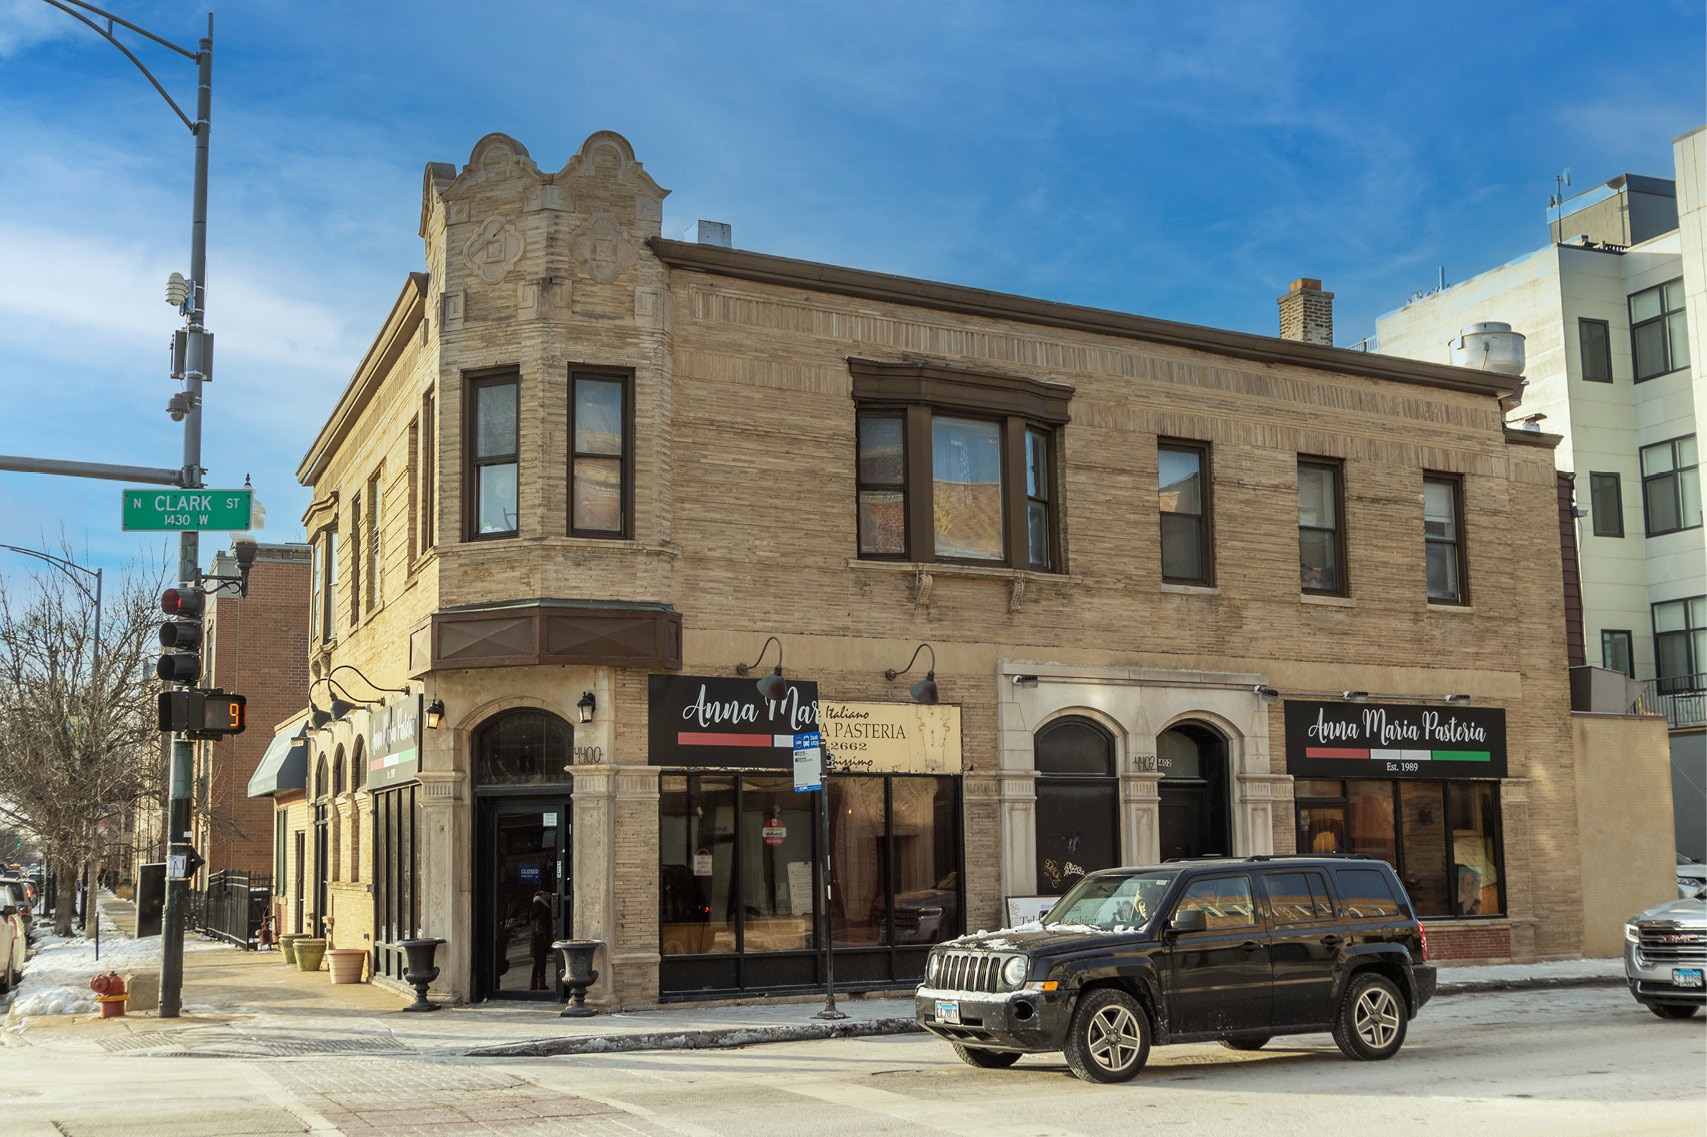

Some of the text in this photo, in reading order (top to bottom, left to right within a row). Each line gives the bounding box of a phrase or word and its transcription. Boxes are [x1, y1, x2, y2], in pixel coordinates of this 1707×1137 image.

[133, 495, 240, 511] N CLARK ST
[164, 514, 209, 525] 1430 W
[682, 683, 760, 728] Anna
[825, 705, 870, 720] Italiano
[229, 703, 239, 727] 9
[834, 722, 907, 740] PASTERIA
[1308, 707, 1487, 746] Anna Maria Pasteria
[1133, 756, 1157, 771] 4402
[1386, 762, 1419, 772] Est. 1989
[1661, 934, 1698, 943] GMC
